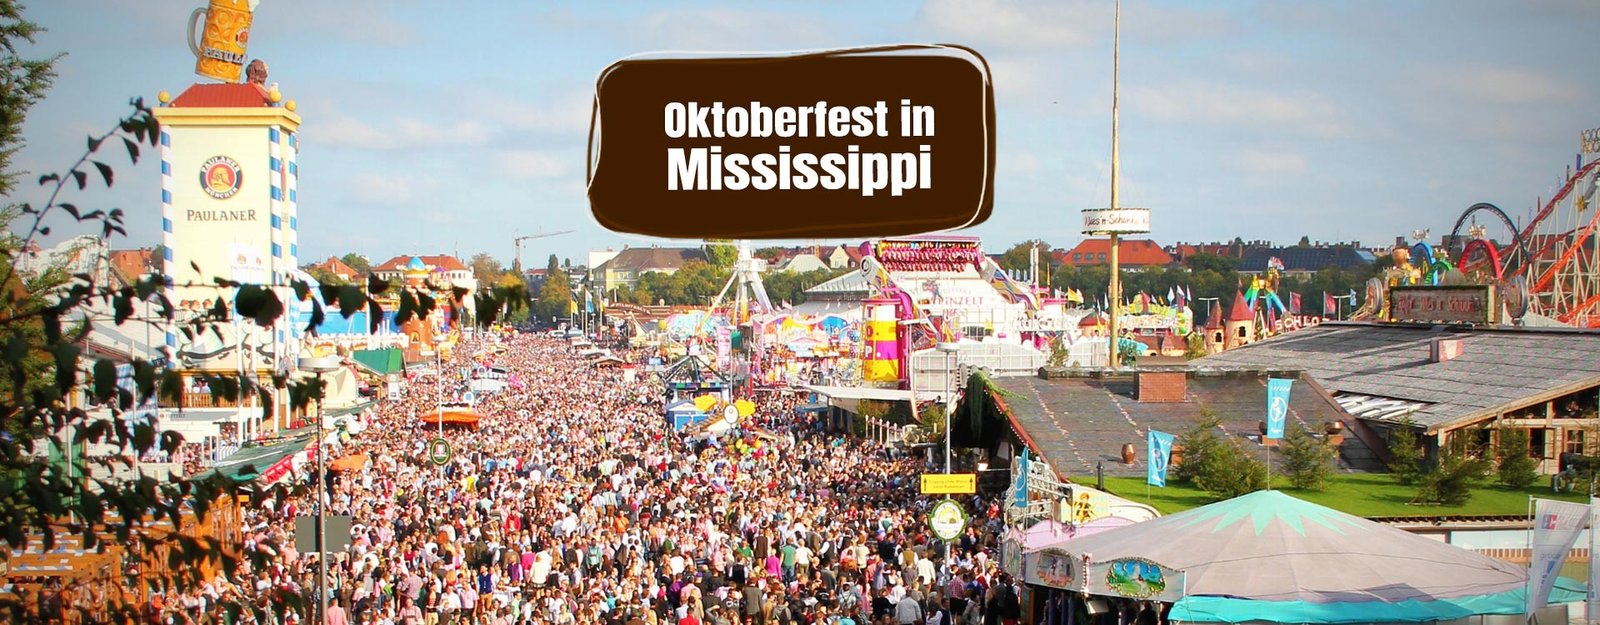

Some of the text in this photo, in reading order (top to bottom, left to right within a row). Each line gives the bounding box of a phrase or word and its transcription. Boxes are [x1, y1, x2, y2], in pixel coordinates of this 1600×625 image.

[201, 156, 241, 174] PAULANER
[186, 208, 257, 222] PAULANER
[1275, 315, 1330, 331] SCHLO
